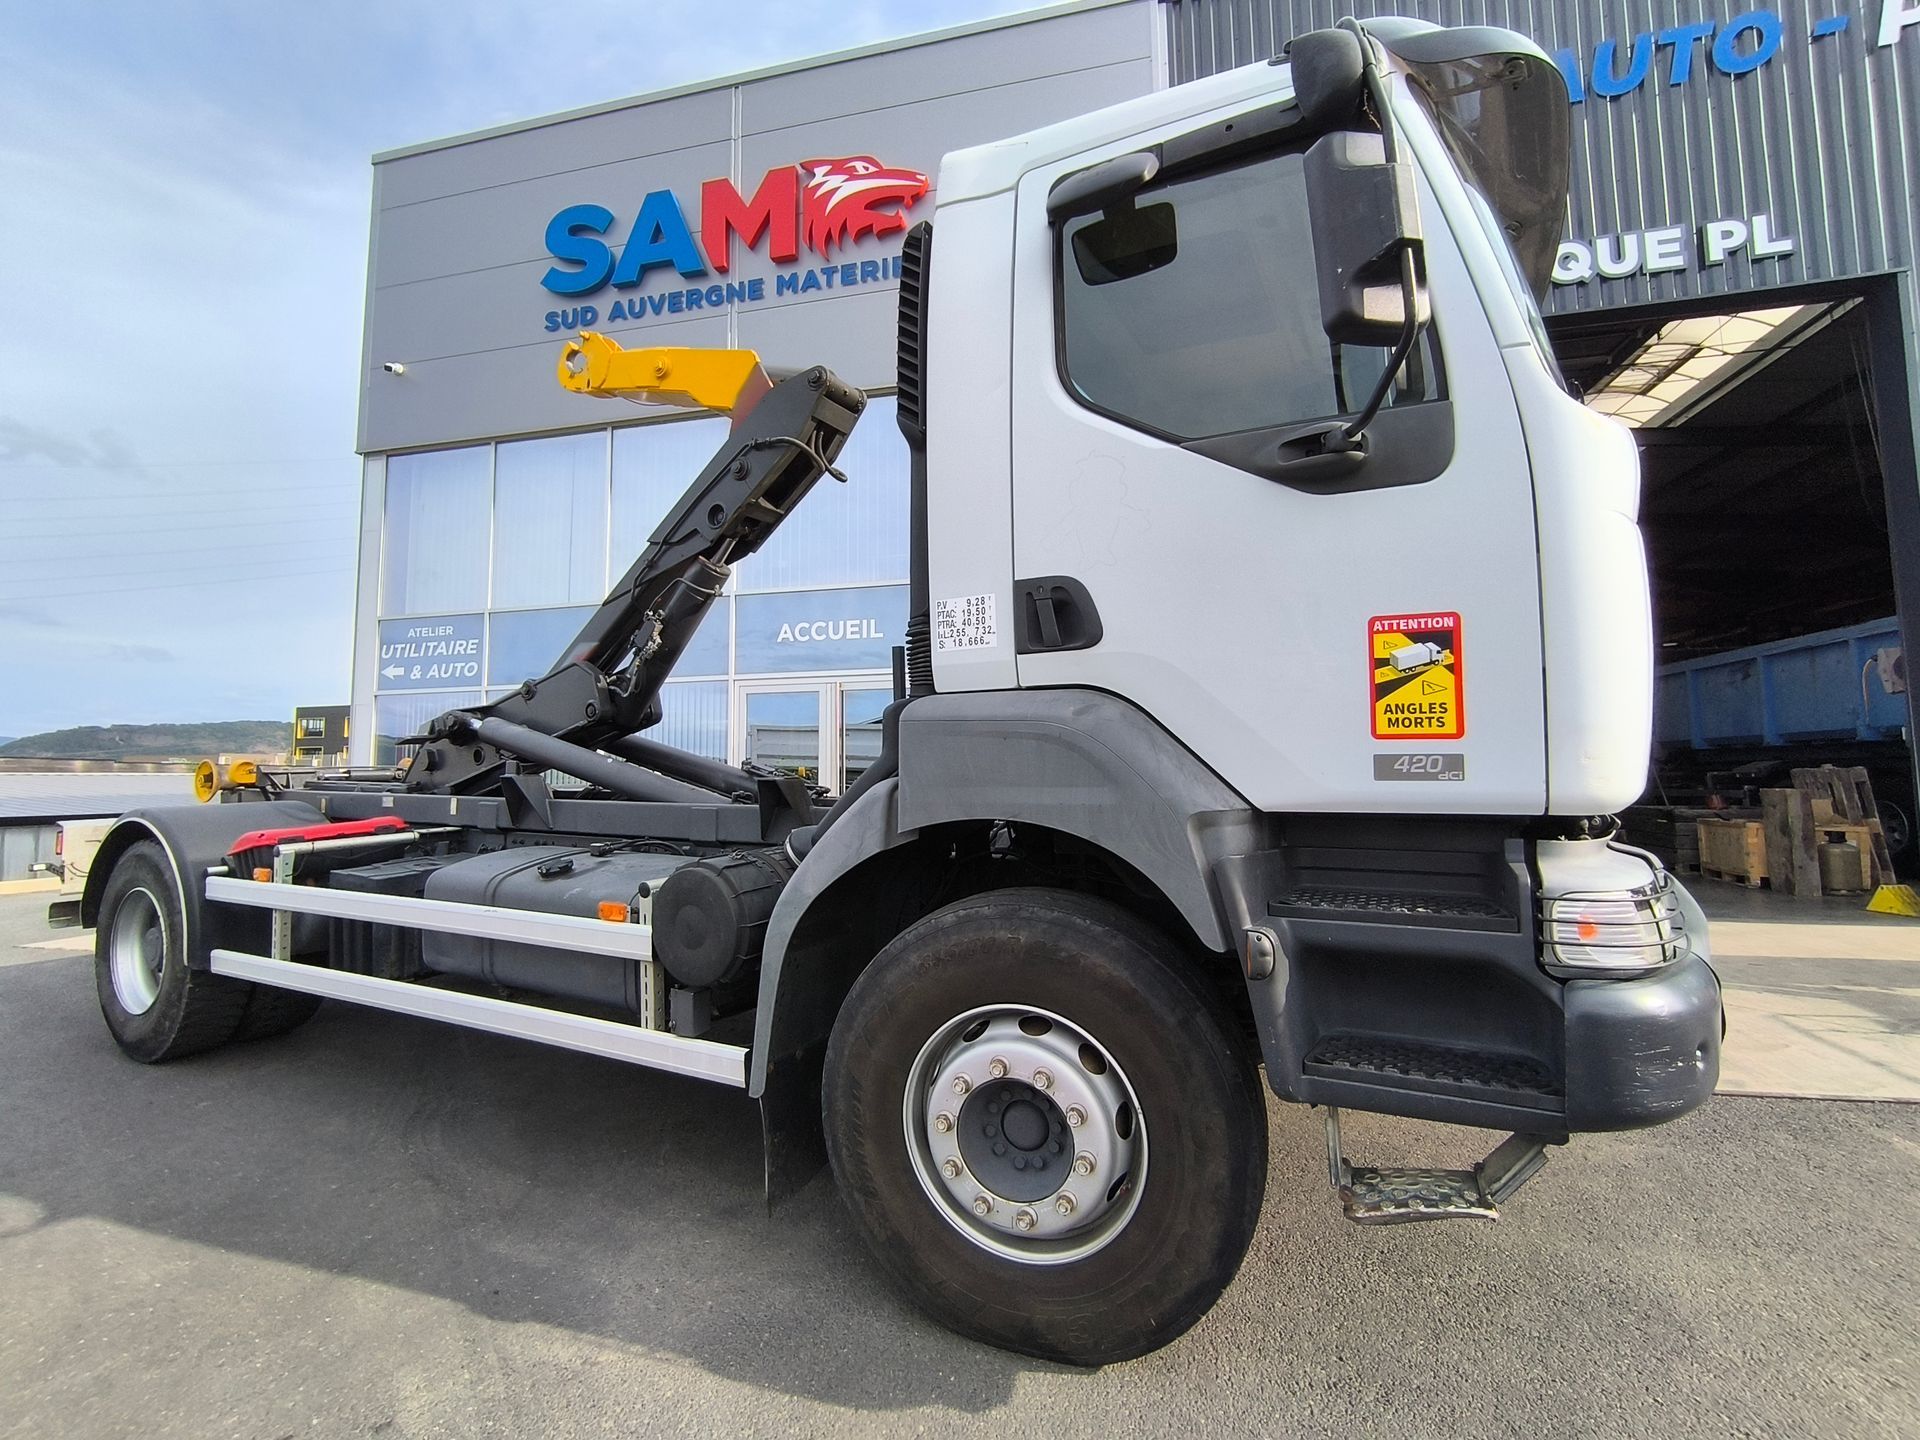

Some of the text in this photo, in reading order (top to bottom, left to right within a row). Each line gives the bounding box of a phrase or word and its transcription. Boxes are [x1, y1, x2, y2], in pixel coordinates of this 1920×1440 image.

[540, 165, 802, 298] SAM
[1705, 214, 1796, 265] PL
[544, 305, 599, 333] SUD
[608, 278, 765, 323] AUVERGNE
[407, 625, 454, 638] ATELIER
[776, 618, 884, 643] ACCUEIL
[1373, 616, 1454, 631] ATTENTION
[381, 639, 479, 659] UTILITAIRE
[410, 661, 478, 680] & AUTO
[1383, 701, 1448, 715] ANGLES
[1387, 716, 1446, 729] MORTS
[1393, 755, 1443, 773] 420
